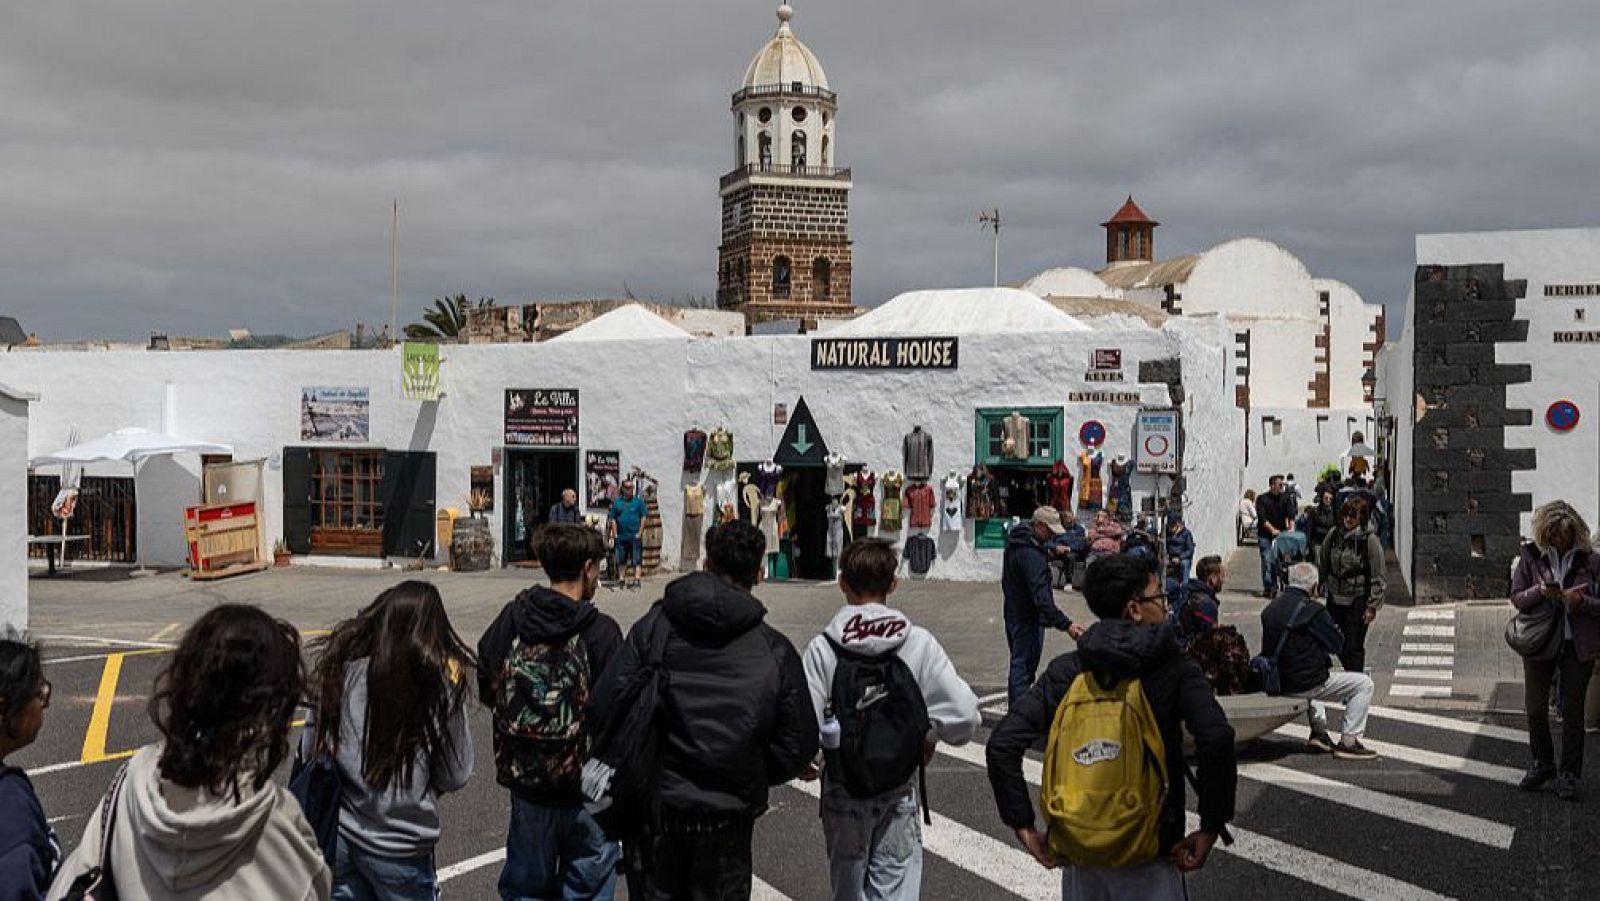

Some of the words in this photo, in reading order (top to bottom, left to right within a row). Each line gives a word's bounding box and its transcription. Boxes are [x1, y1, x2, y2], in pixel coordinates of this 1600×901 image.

[1575, 308, 1584, 320] Y
[816, 340, 890, 367] NATURAL
[896, 339, 953, 366] HOUSE
[1084, 372, 1124, 382] REYES
[533, 391, 549, 406] La
[550, 391, 577, 406] Villa
